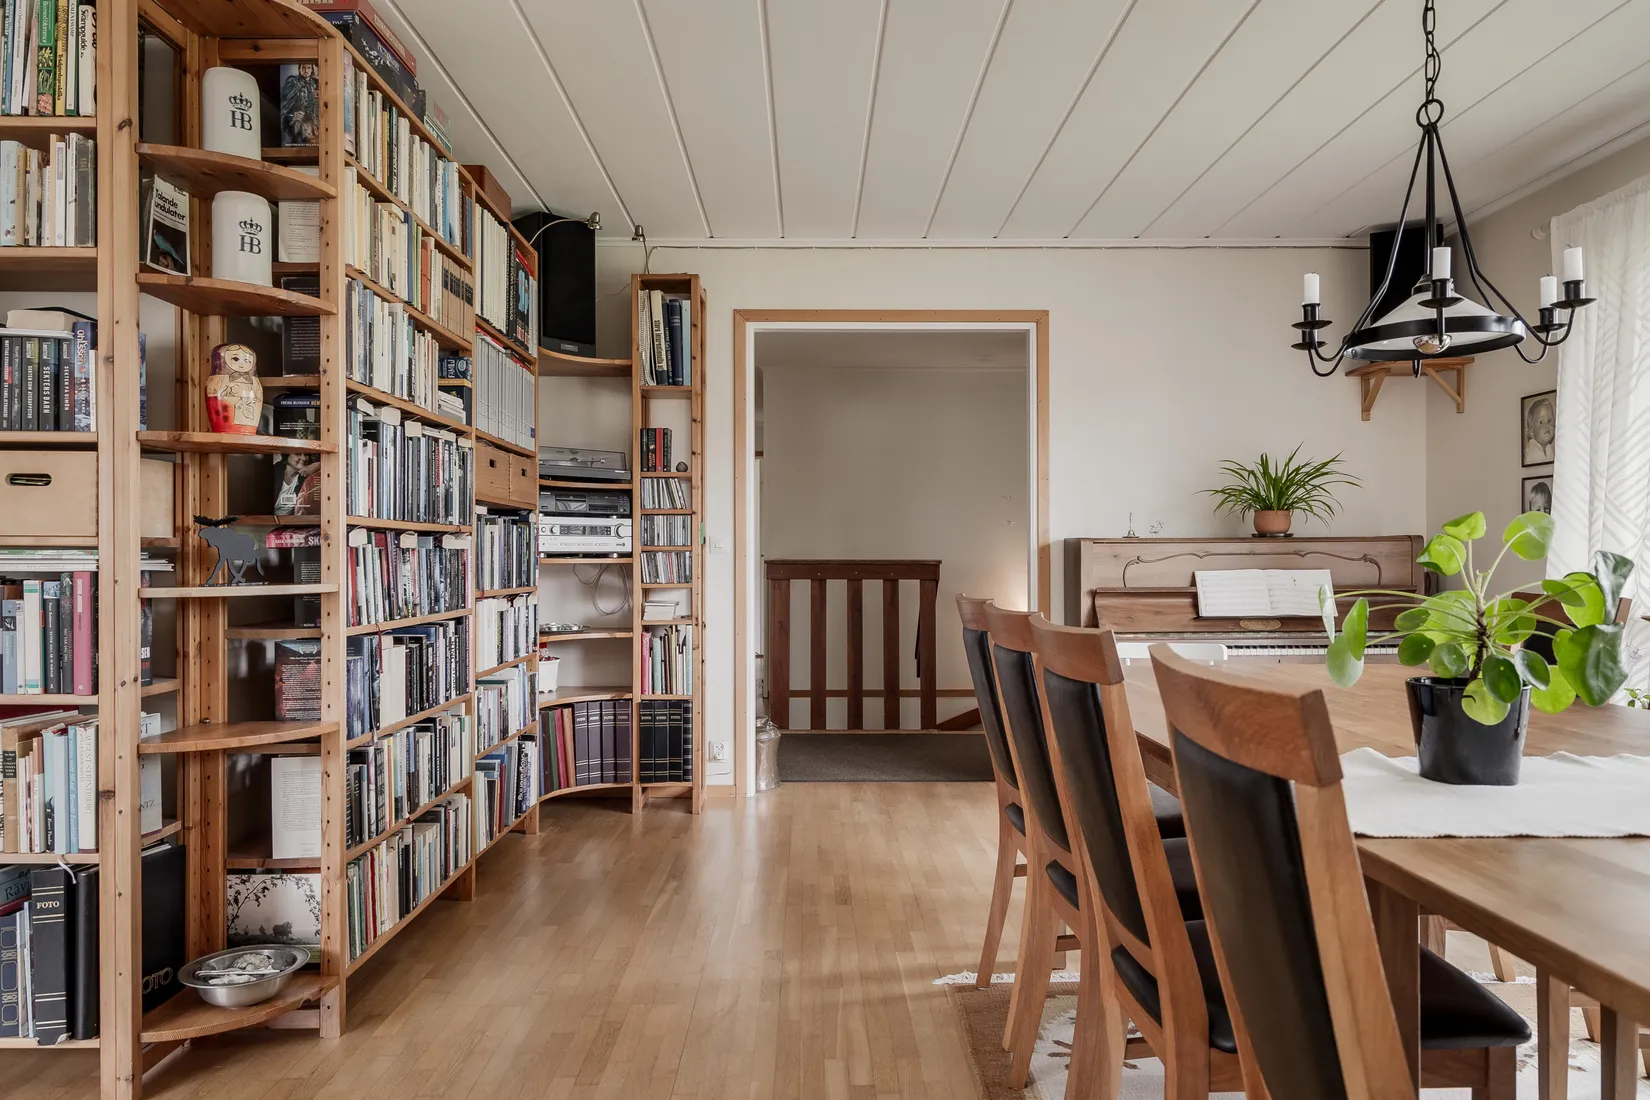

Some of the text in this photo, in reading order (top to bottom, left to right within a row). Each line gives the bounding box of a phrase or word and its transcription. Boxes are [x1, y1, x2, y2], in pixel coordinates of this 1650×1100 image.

[79, 8, 89, 50] Svampguide
[154, 200, 186, 221] undulater
[155, 188, 179, 209] Talande
[77, 329, 86, 364] Ohlsson
[36, 900, 60, 909] FOTO
[142, 966, 173, 995] OTO
